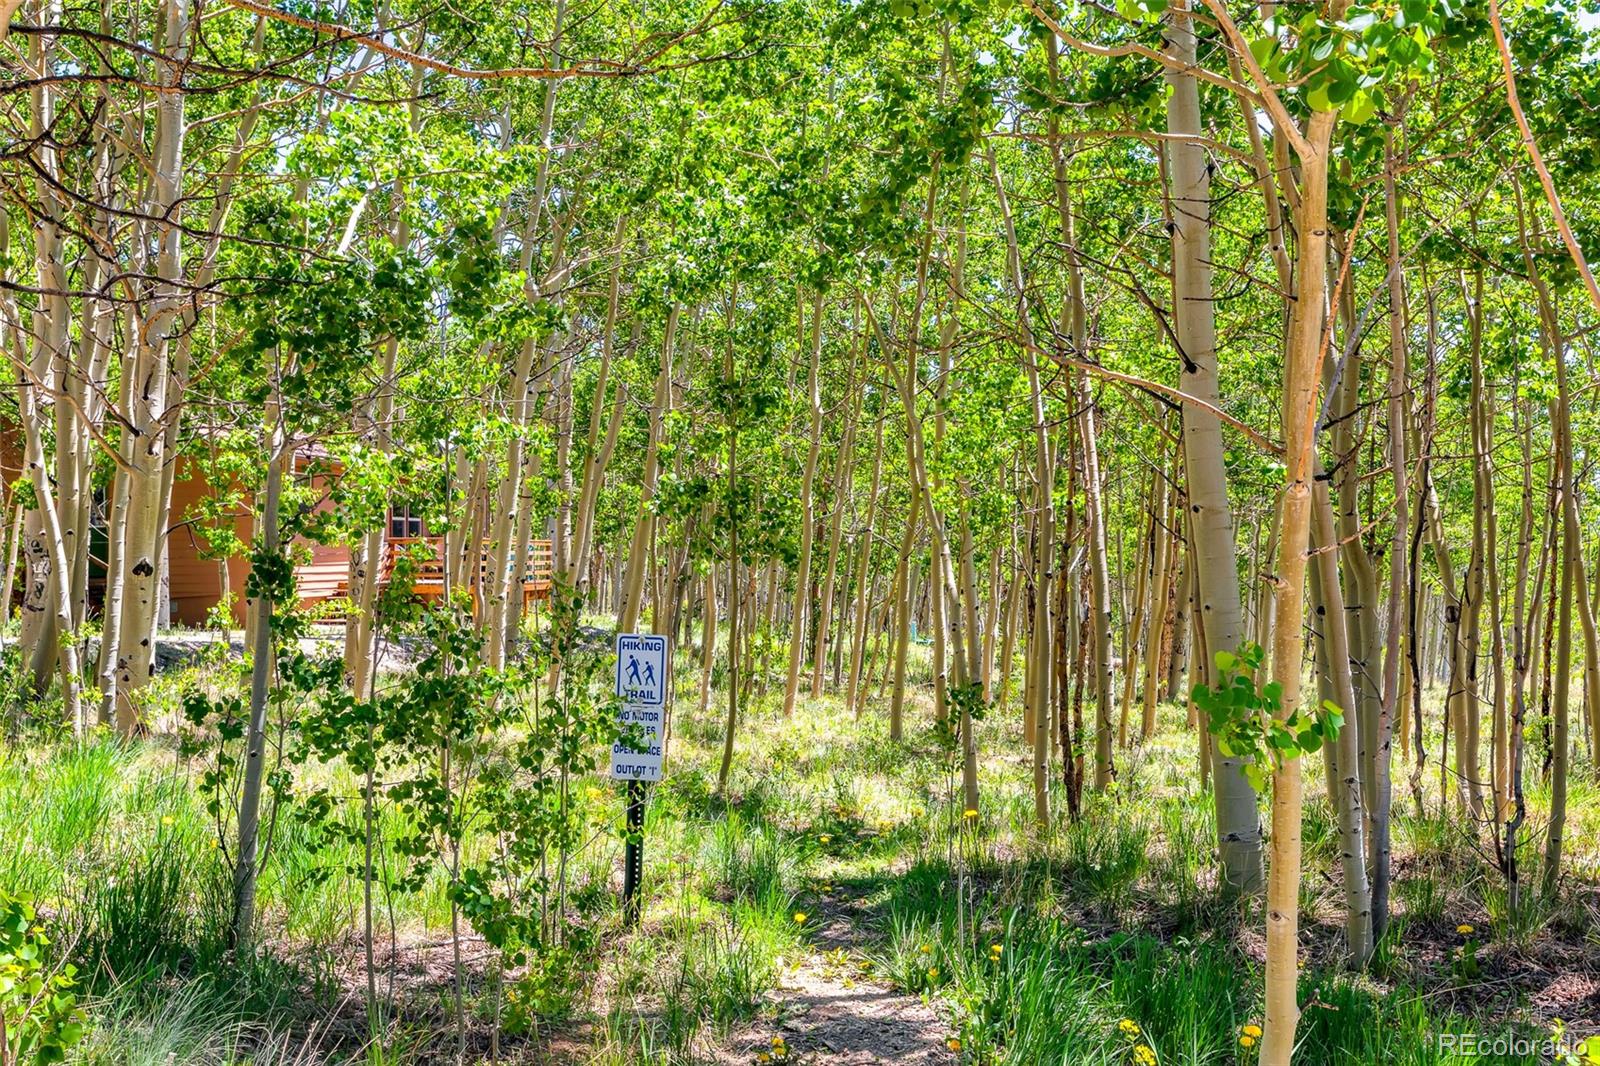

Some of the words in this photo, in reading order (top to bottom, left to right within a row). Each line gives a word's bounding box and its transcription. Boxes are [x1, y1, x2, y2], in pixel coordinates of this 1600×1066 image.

[622, 641, 662, 652] HIKING
[624, 689, 656, 700] TRAIL
[616, 764, 647, 775] OUTLOT
